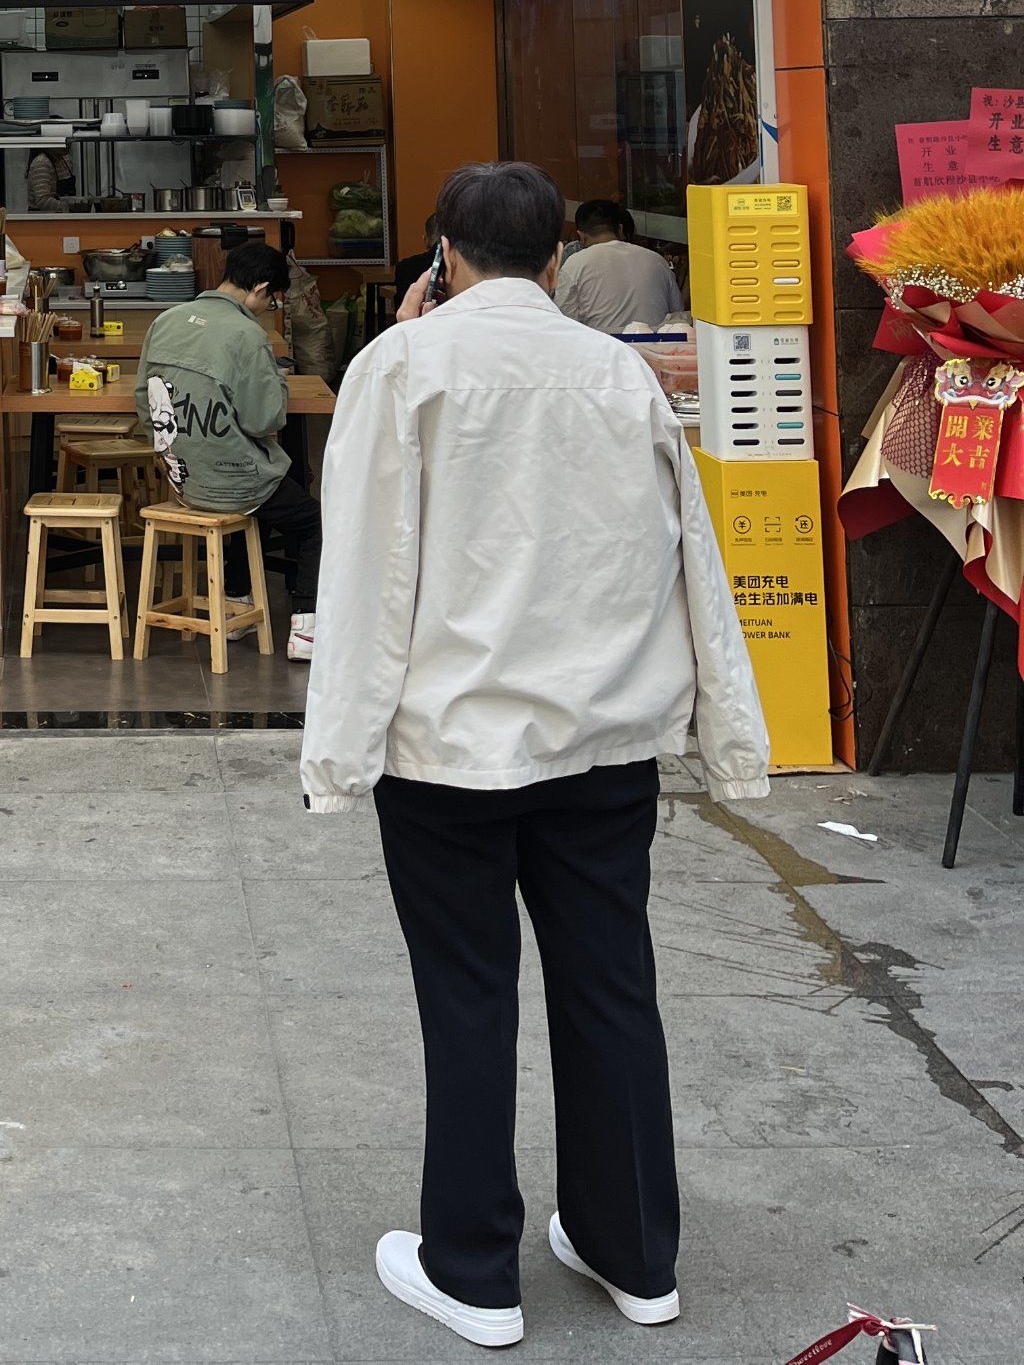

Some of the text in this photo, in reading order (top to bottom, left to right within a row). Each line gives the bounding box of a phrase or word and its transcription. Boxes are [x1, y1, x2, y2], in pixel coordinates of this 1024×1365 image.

[987, 135, 1024, 154] 生意
[945, 415, 994, 440] 開業
[941, 442, 990, 469] 大吉
[733, 575, 789, 589] 美团充电
[734, 592, 818, 606] 给生活加满电
[768, 631, 791, 639] BANK
